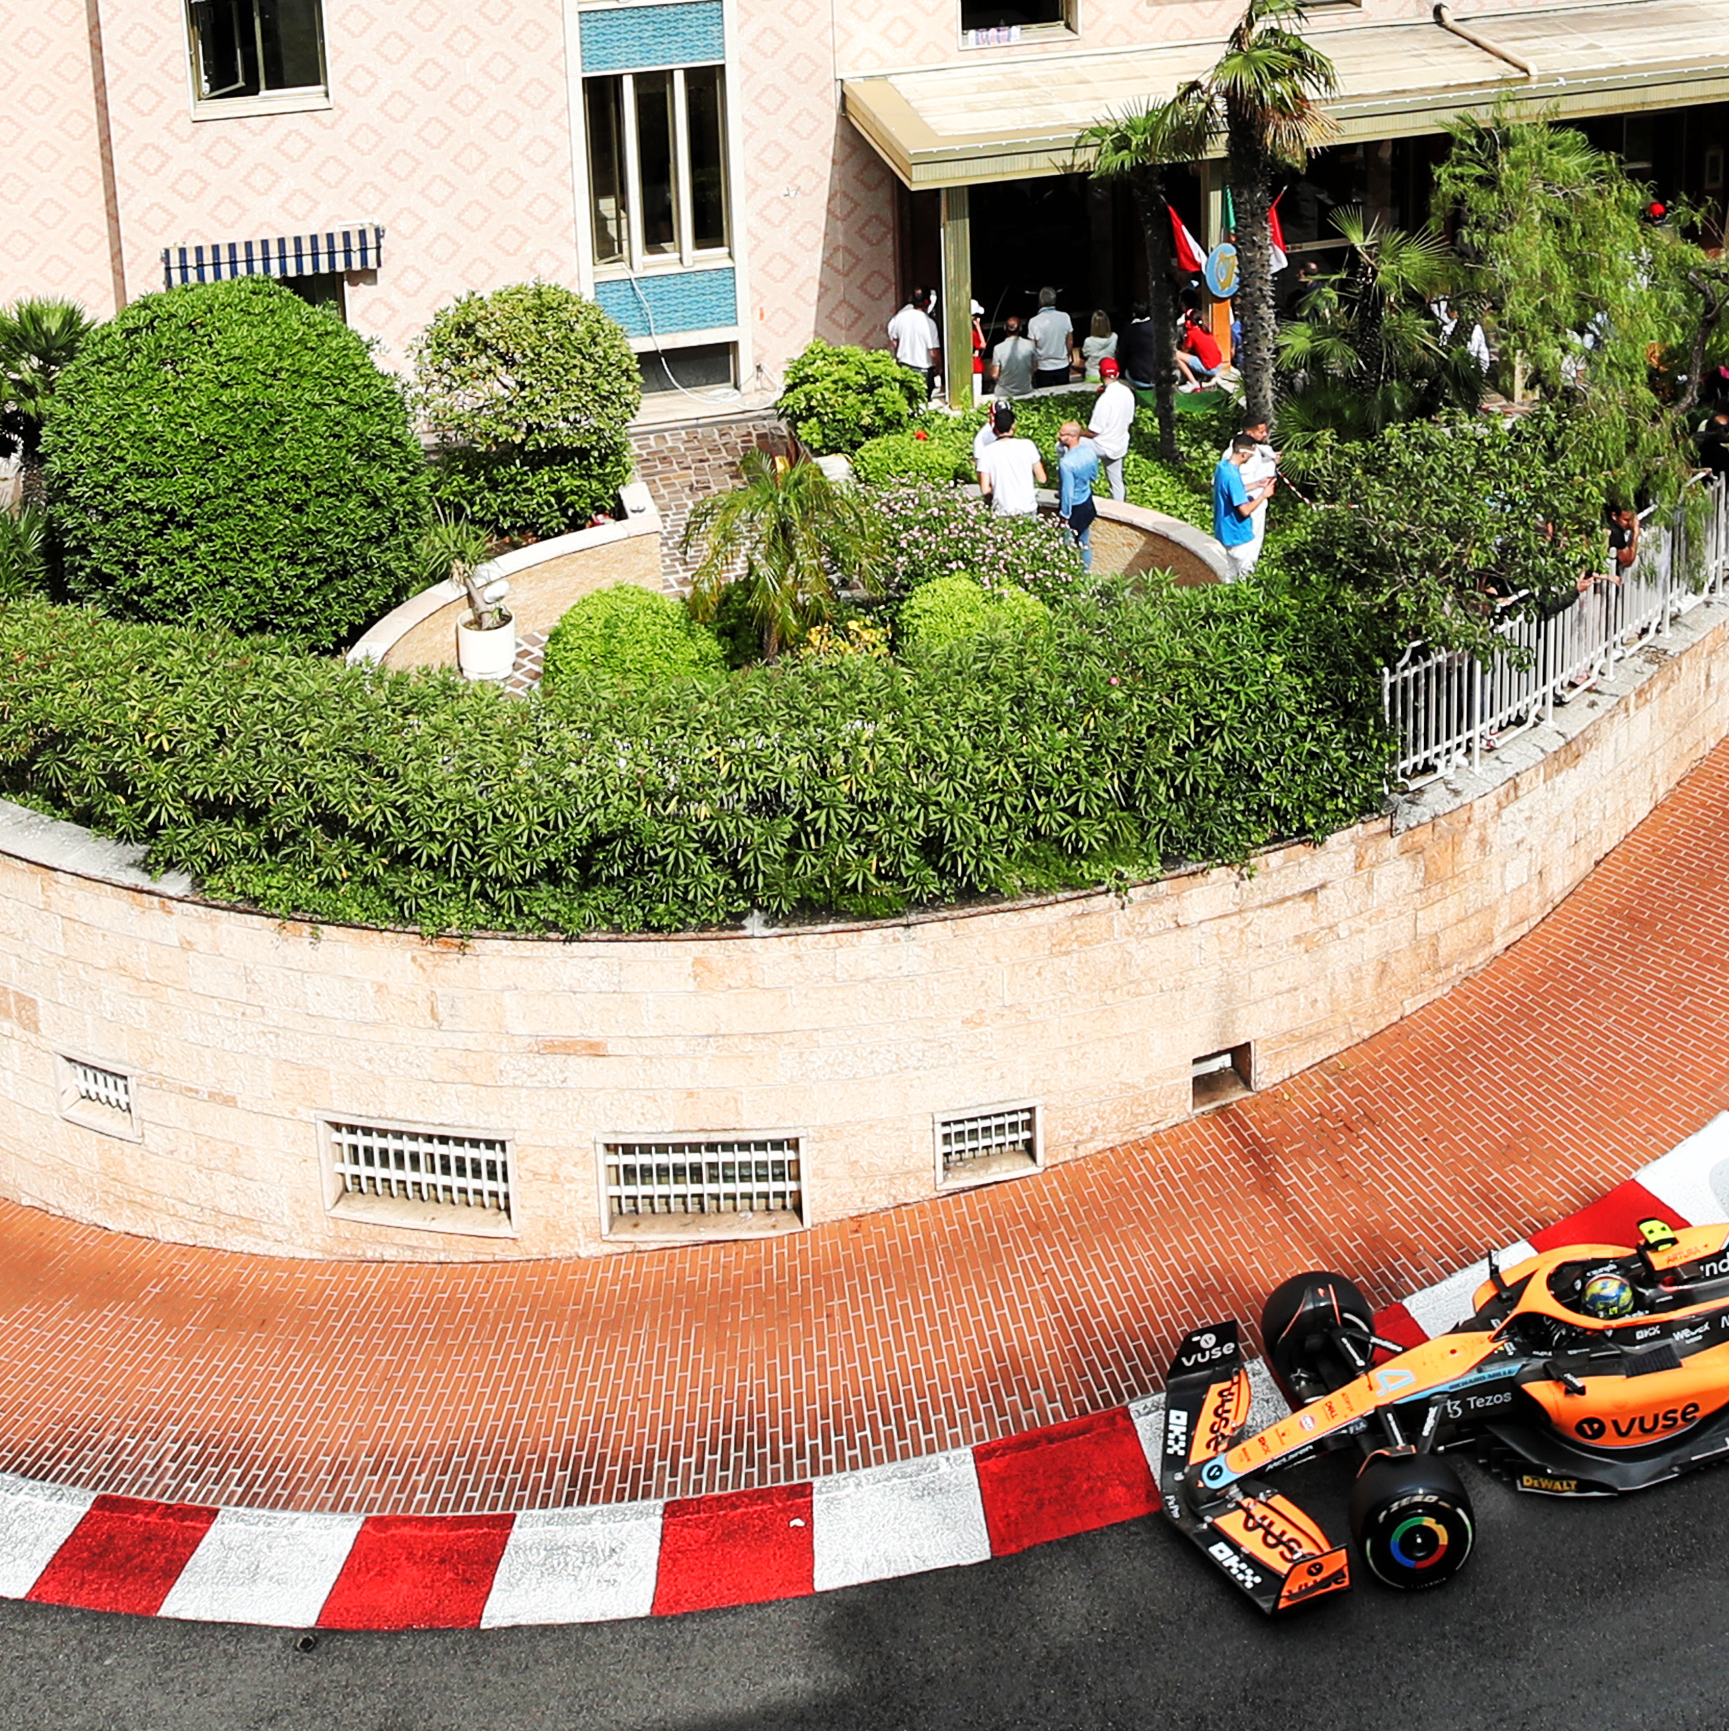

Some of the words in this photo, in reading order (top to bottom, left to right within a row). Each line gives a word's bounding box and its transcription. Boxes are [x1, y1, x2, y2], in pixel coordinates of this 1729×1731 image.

[1376, 1368, 1418, 1397] 4
[1466, 1392, 1513, 1411] Tezos
[1208, 1541, 1263, 1590] OKX
